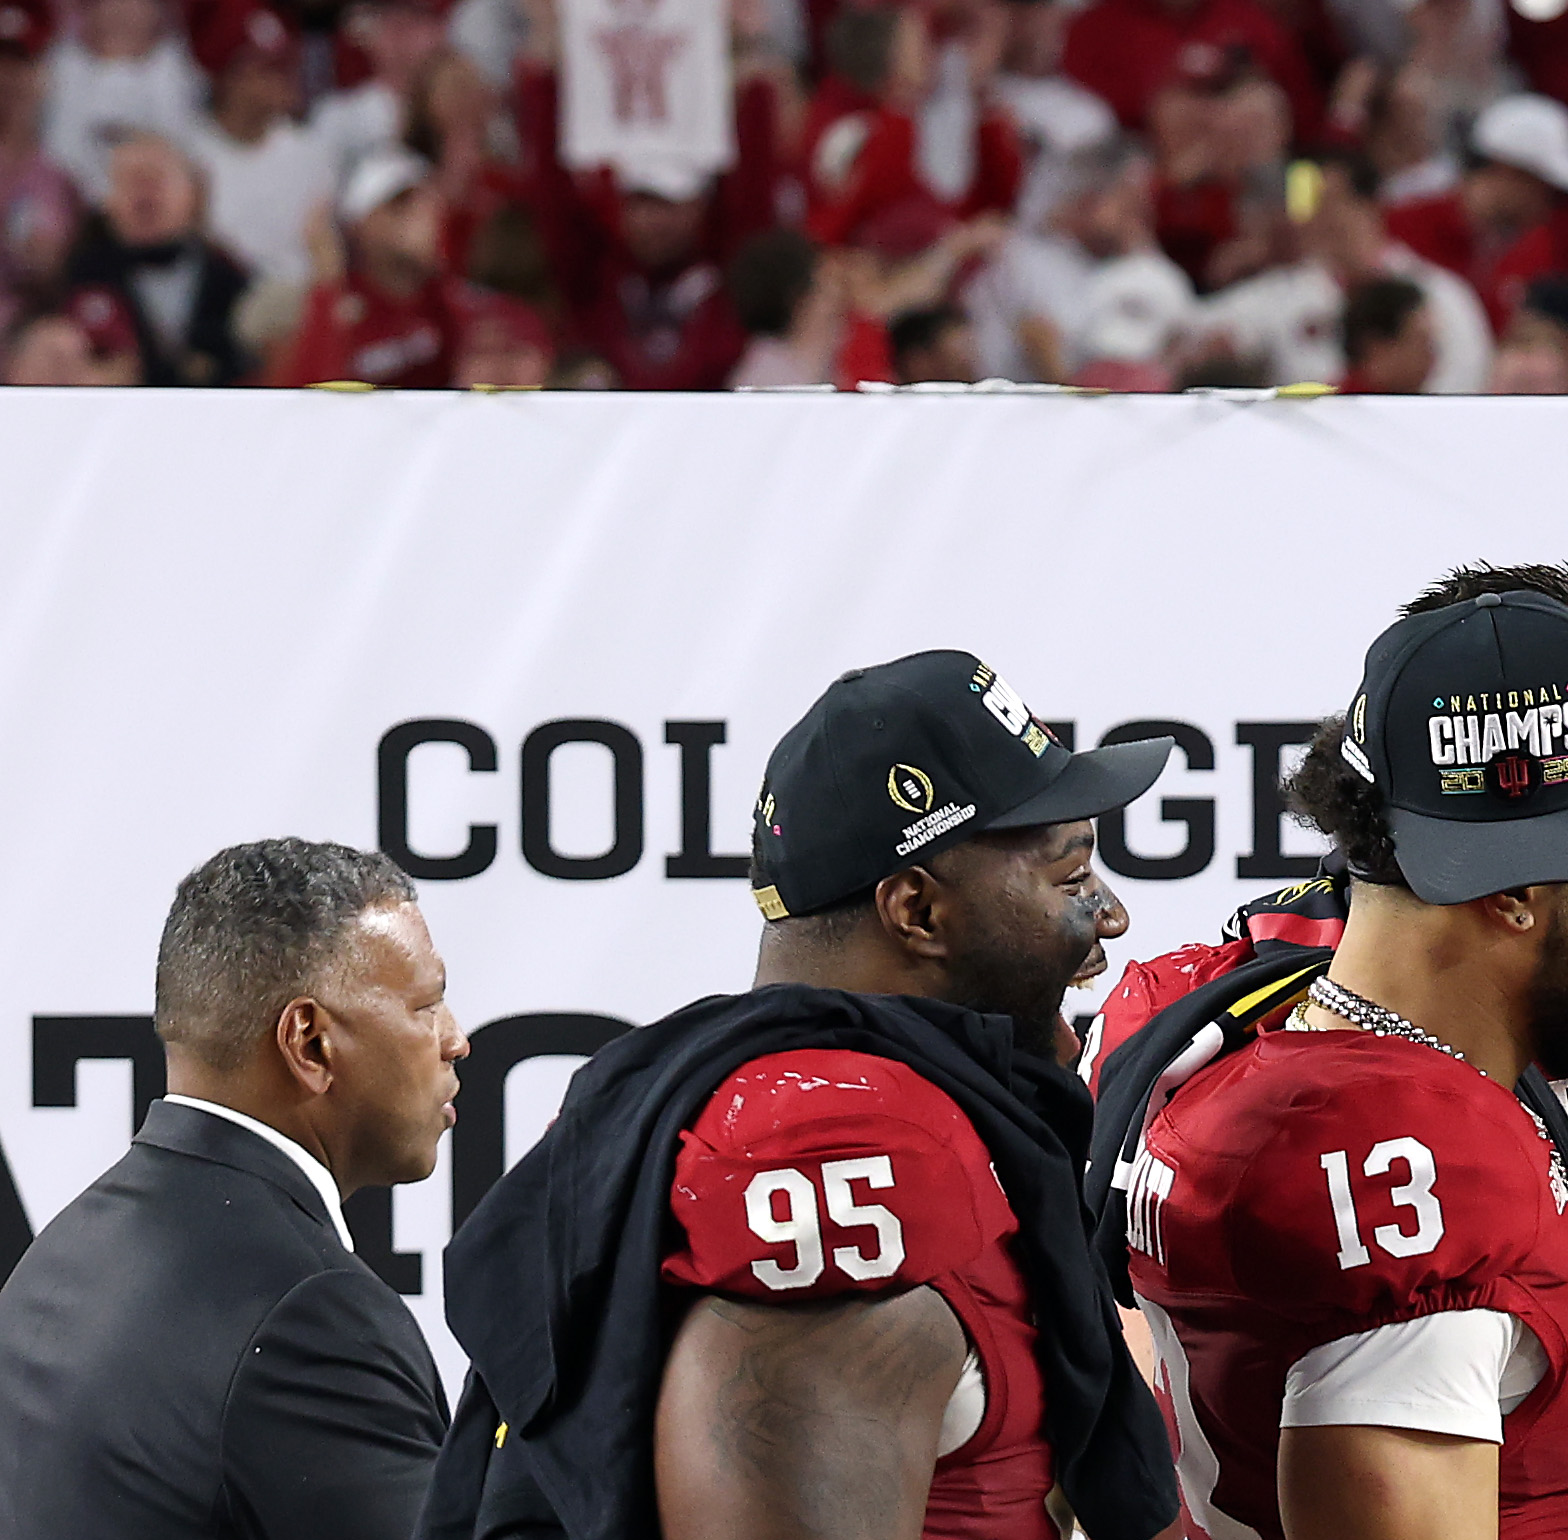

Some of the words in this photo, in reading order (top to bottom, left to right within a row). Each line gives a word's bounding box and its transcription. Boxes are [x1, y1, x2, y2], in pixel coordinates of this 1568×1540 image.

[1449, 684, 1562, 713] NATIONAL
[895, 804, 977, 856] CHAMPIONSHIP
[902, 802, 961, 839] NATIONAL
[743, 1155, 906, 1291] 95
[1320, 1136, 1445, 1270] 13
